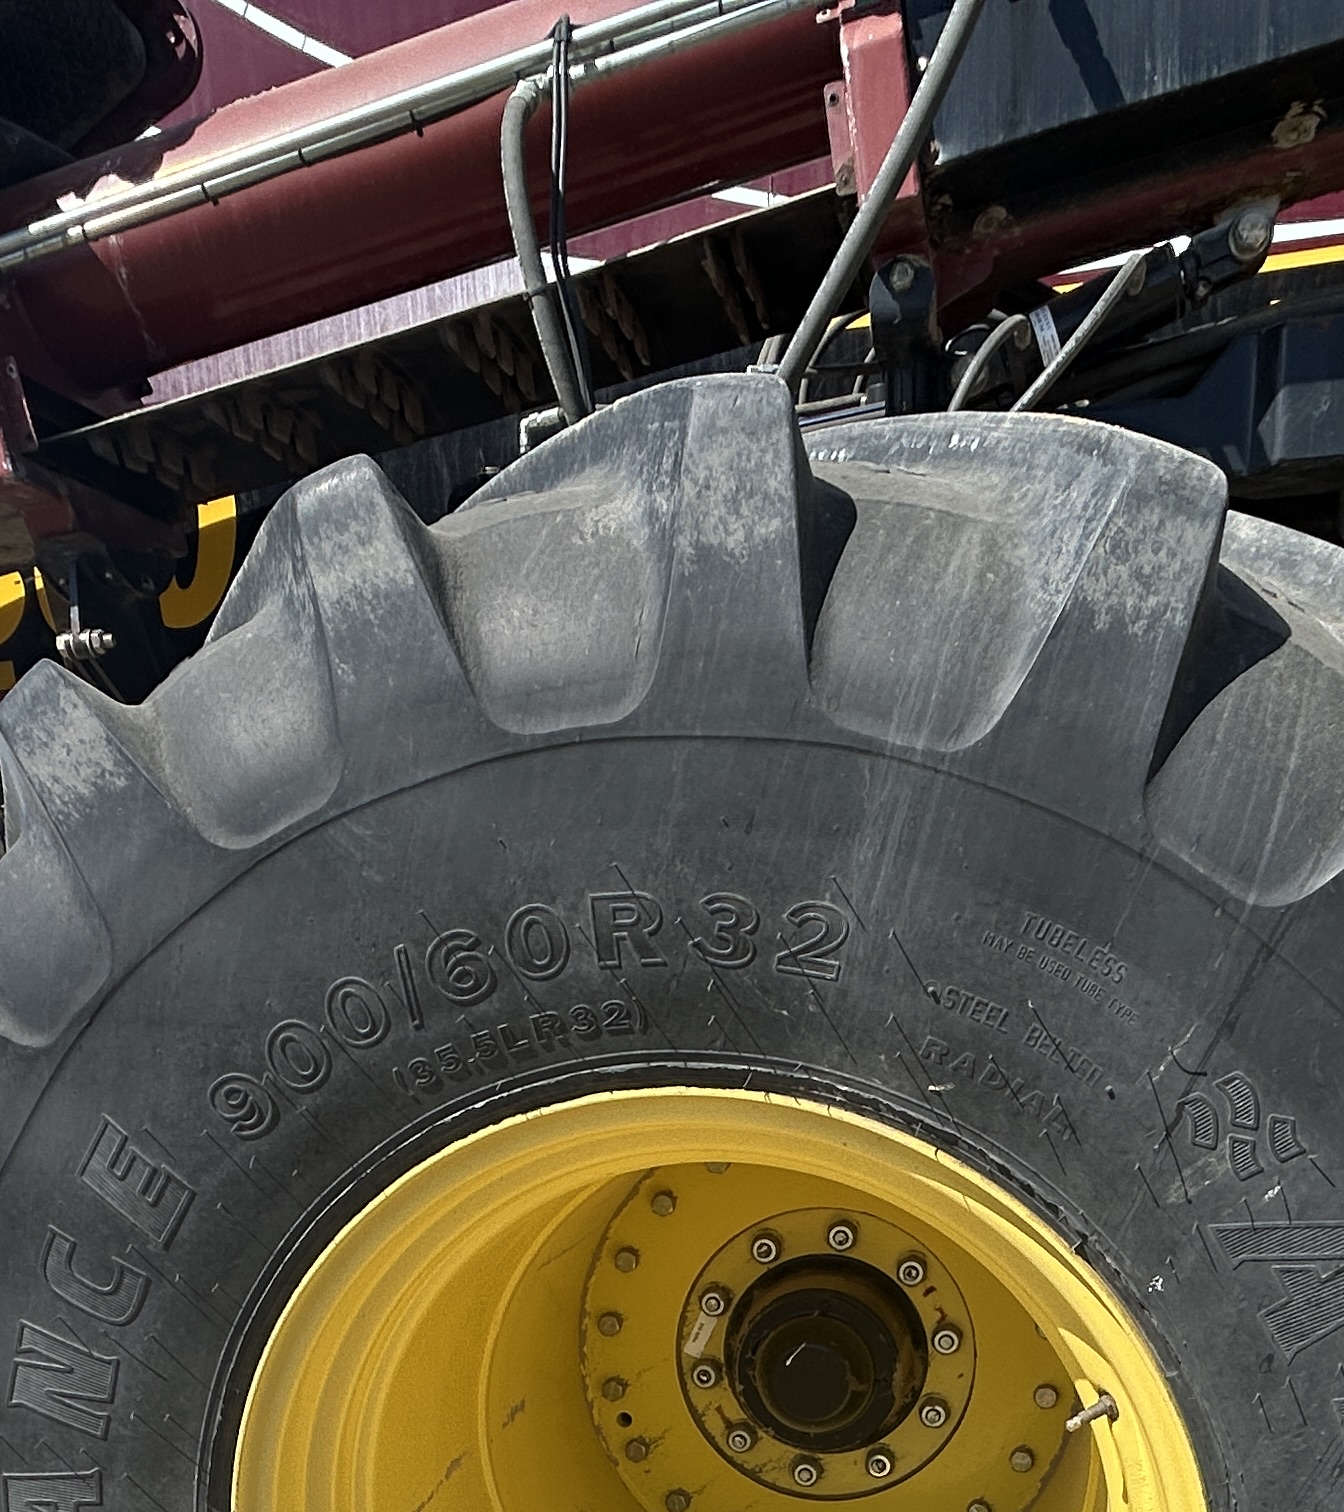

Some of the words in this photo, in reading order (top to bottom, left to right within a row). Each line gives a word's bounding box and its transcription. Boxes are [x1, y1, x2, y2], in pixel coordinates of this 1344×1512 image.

[982, 931, 1014, 954] MAY
[1016, 945, 1036, 965] BE
[1038, 955, 1072, 982] USED
[1073, 976, 1106, 1002] TUBE
[1106, 999, 1140, 1026] TYPE
[1019, 911, 1128, 985] TUBELESS
[941, 985, 1012, 1034] STEEL
[1023, 1024, 1105, 1088] BELTED
[919, 1035, 1069, 1137] RADIAL
